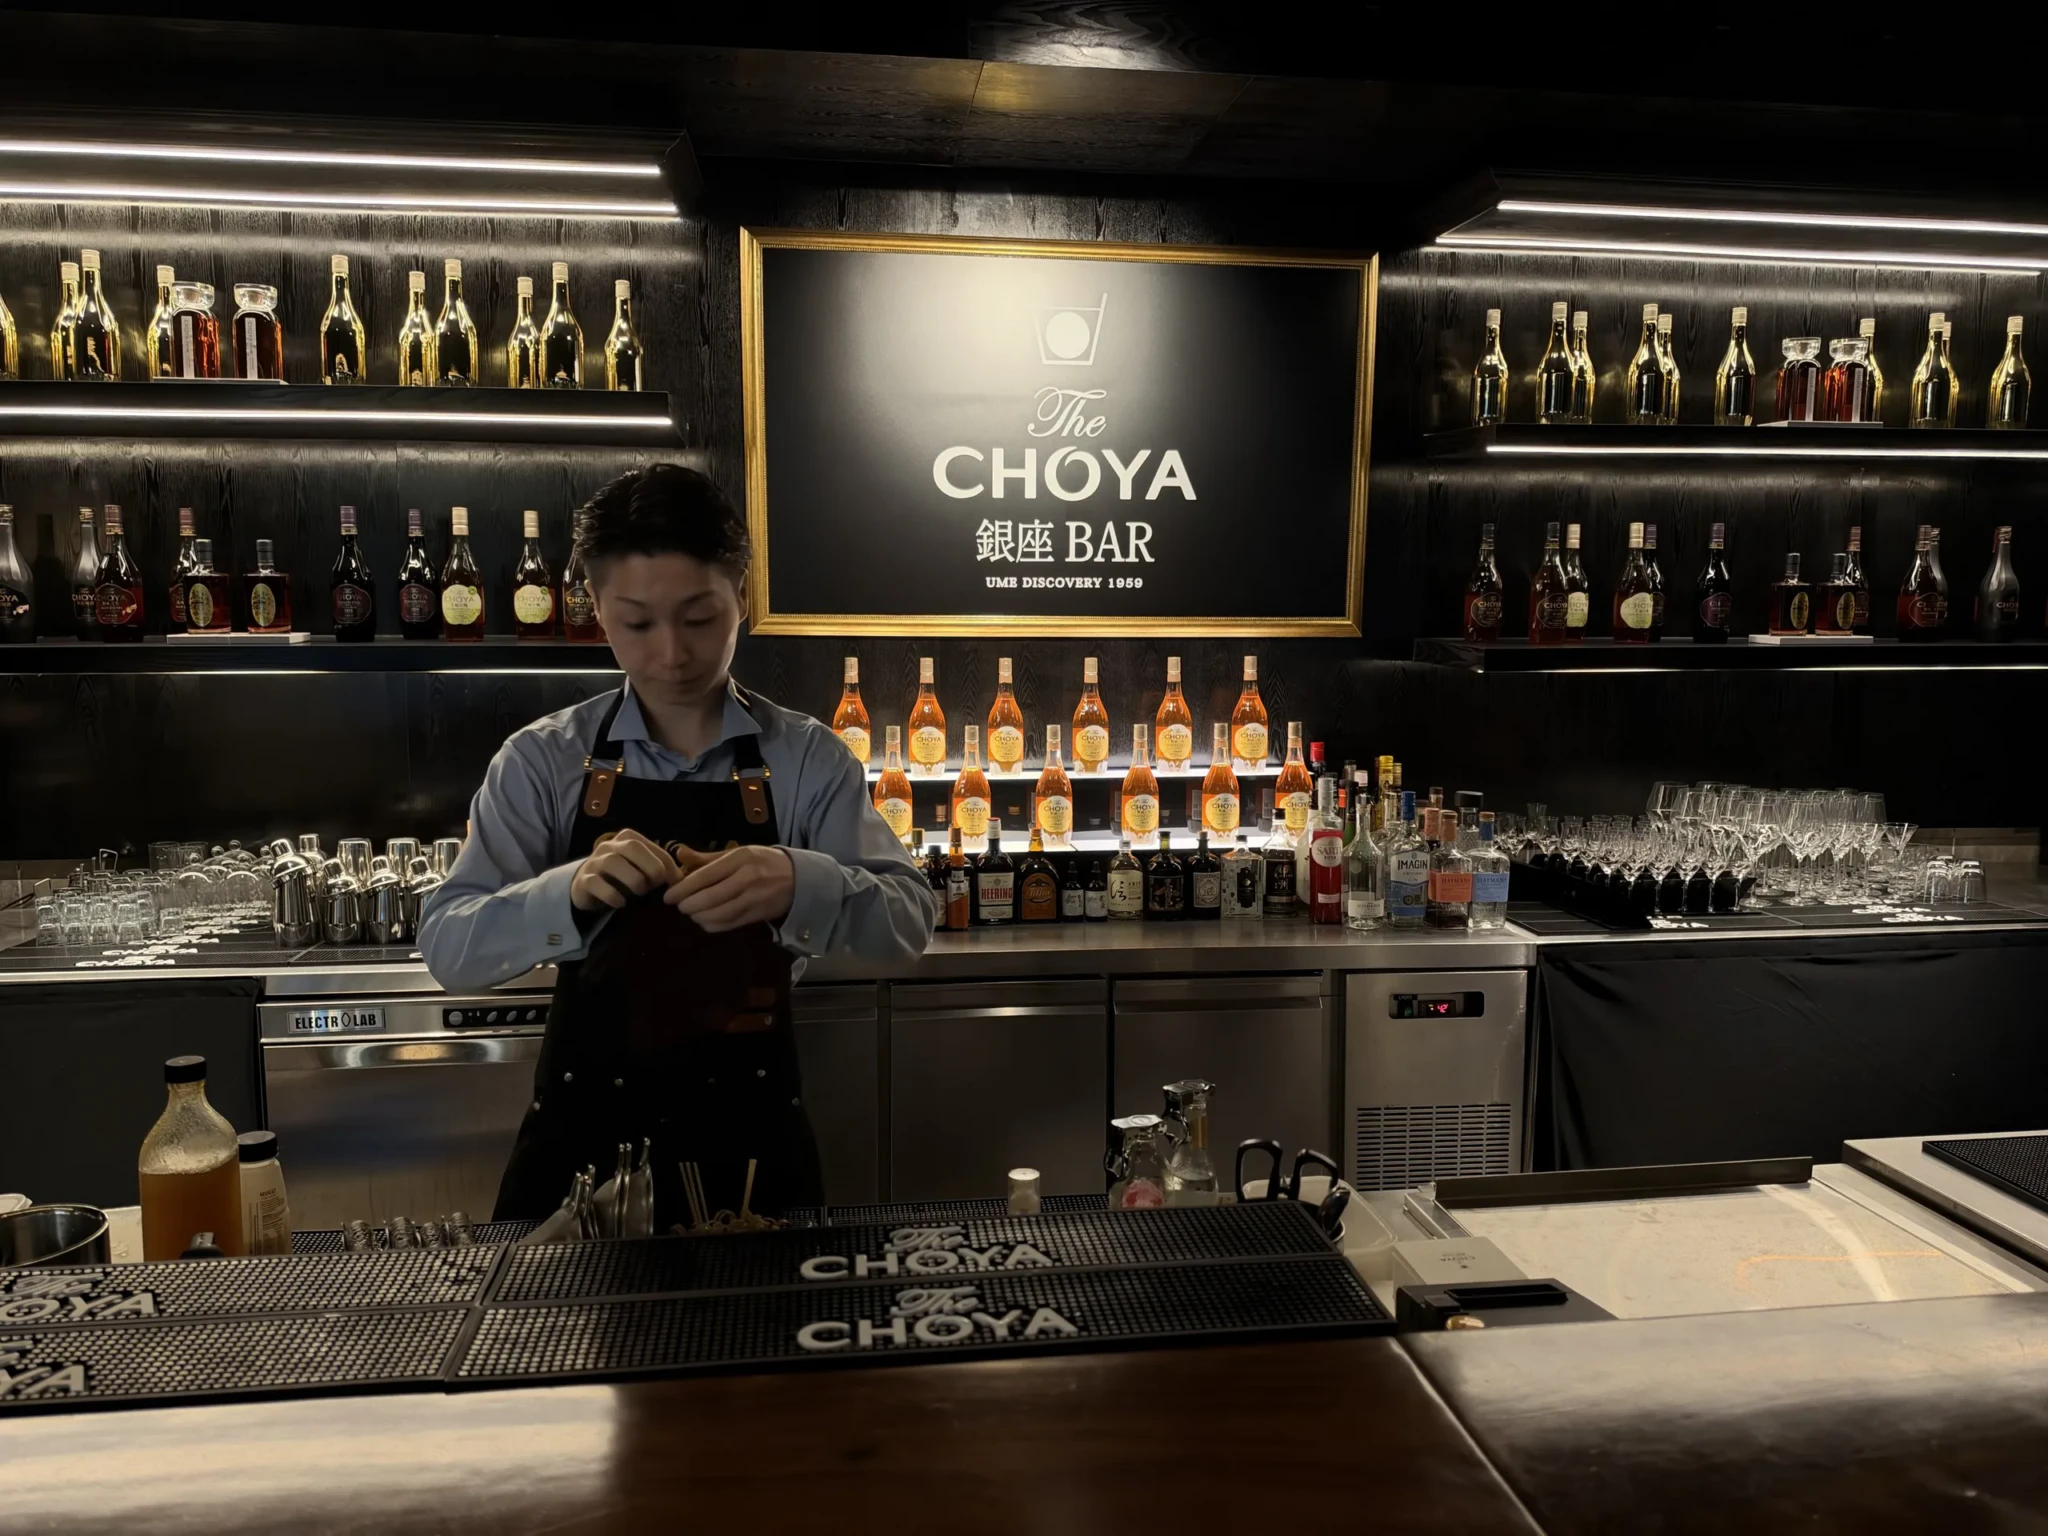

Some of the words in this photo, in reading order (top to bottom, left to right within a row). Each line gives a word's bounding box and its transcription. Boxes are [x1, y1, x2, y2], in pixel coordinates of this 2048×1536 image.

[1027, 386, 1107, 437] The
[933, 446, 1197, 502] CHOYA
[975, 518, 1055, 563] 銀座
[1065, 520, 1155, 563] BAR
[985, 576, 1018, 588] UME
[1022, 576, 1103, 588] DISCOVERY
[1108, 577, 1143, 588] 1959
[1398, 859, 1428, 870] IMAGIN
[981, 887, 1012, 900] HEERING
[884, 1226, 965, 1252] The
[800, 1244, 1054, 1281] CHOYA
[890, 1286, 979, 1318] The
[797, 1308, 1078, 1350] CHOYA
